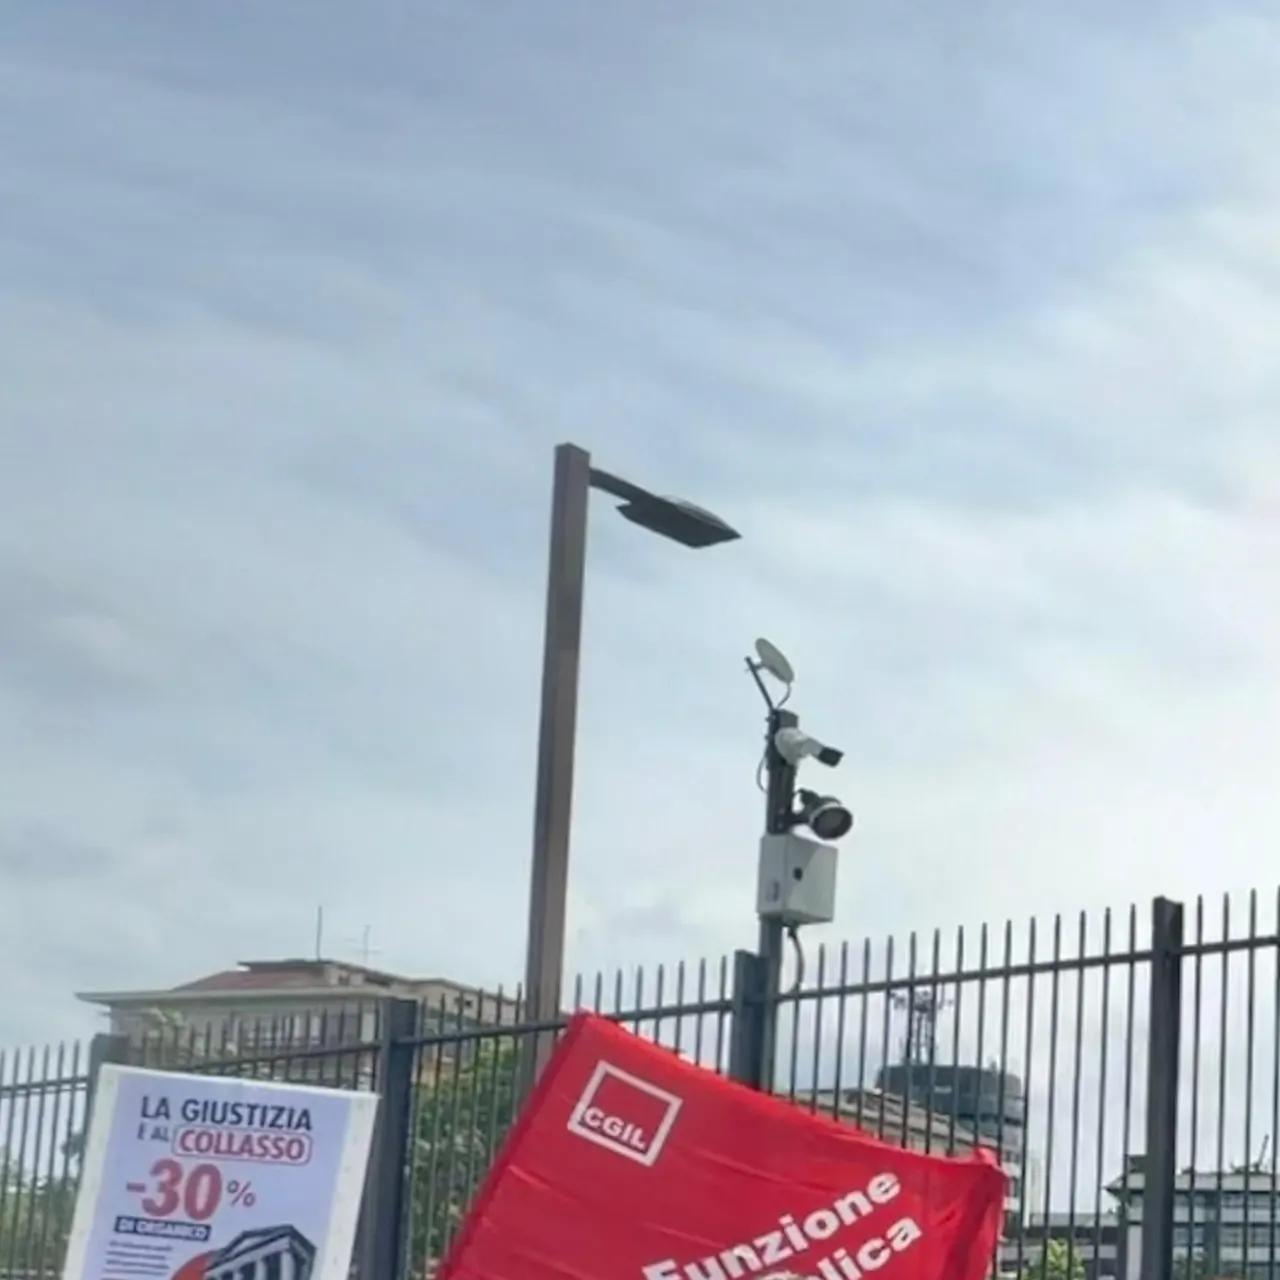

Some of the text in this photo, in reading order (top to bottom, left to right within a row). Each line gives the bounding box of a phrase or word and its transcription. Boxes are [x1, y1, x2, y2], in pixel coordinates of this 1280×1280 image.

[140, 1096, 313, 1131] LA GIUSTIZIA
[583, 1107, 647, 1150] CGIL
[152, 1127, 169, 1142] AL
[180, 1129, 306, 1160] COLLASSO
[126, 1158, 257, 1221] -30%
